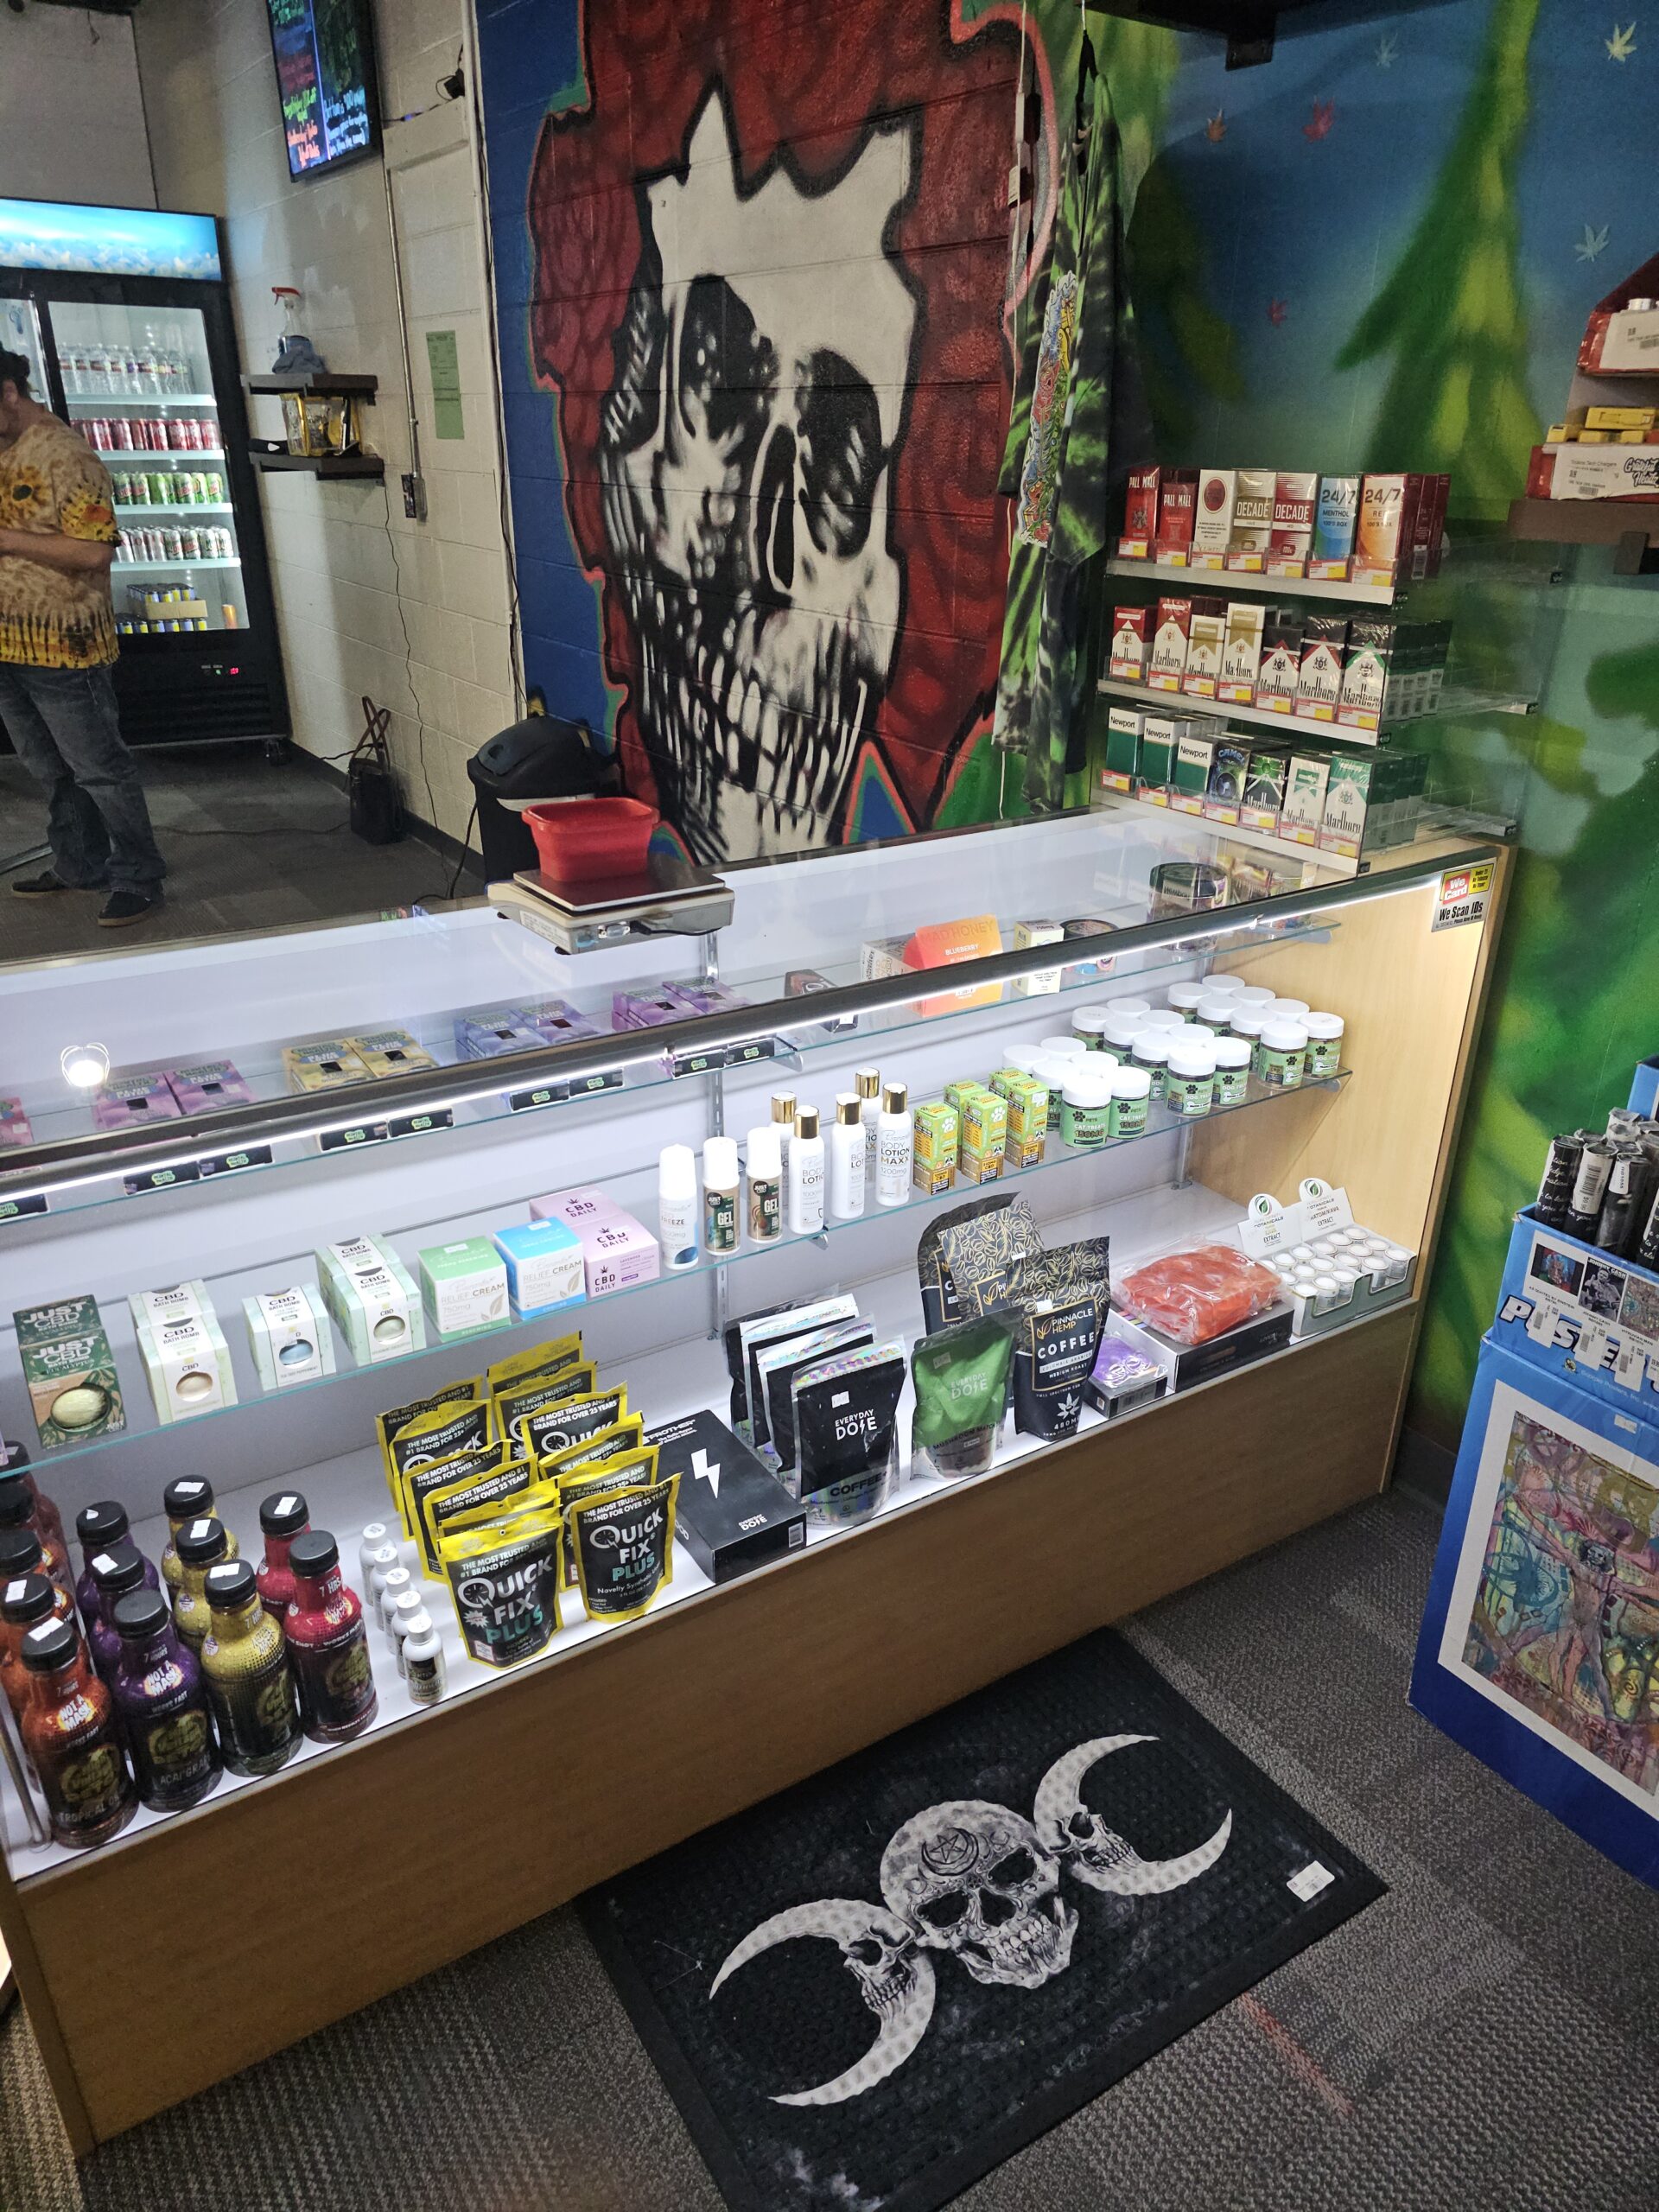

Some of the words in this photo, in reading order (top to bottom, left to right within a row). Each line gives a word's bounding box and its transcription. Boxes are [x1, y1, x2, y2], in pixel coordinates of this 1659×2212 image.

[1128, 476, 1140, 488] PALL
[1142, 476, 1155, 488] MALL
[1163, 494, 1175, 506] PALL
[1178, 494, 1192, 507] MALL
[1321, 489, 1356, 505] 24/7
[1364, 488, 1402, 505] 24/7
[1236, 501, 1268, 518] DECADE
[1275, 504, 1310, 520] DECADE
[1155, 648, 1181, 668] Marlboro
[1300, 677, 1335, 701] Marlboro
[1110, 716, 1135, 728] Newport
[1146, 728, 1171, 740] Newport
[1180, 746, 1208, 760] Newport
[1218, 748, 1245, 766] CAMEL
[1247, 792, 1280, 811] Marlboro
[1326, 810, 1361, 834] Marlboro
[1450, 877, 1466, 889] We
[1445, 885, 1468, 900] Card
[1440, 908, 1451, 921] We
[1452, 905, 1470, 918] Scan
[1471, 900, 1484, 914] IDs
[952, 920, 994, 938] HONEY
[945, 944, 979, 956] BLUEBERRY
[880, 1141, 905, 1150] BODY
[880, 1147, 910, 1157] LOTION
[565, 1202, 594, 1213] CBD
[570, 1207, 597, 1217] DAILY
[764, 1199, 779, 1212] GEL
[717, 1211, 734, 1225] GEL
[1318, 1217, 1333, 1226] EXTRACT
[601, 1236, 630, 1249] DAILY
[1263, 1233, 1281, 1243] EXTRACT
[341, 1244, 365, 1254] CBD
[552, 1260, 582, 1274] CREAM
[1588, 1258, 1610, 1270] JOHNNY
[1611, 1268, 1626, 1278] CASH
[360, 1274, 385, 1285] CBD
[594, 1274, 615, 1286] CBD
[595, 1282, 616, 1293] DAILY
[155, 1292, 184, 1302] CBD
[473, 1282, 505, 1297] CREAM
[270, 1296, 296, 1306] CBD
[23, 1301, 86, 1324] JUST
[34, 1312, 79, 1329] CBD
[1052, 1308, 1094, 1327] PINNACLE
[164, 1326, 194, 1338] CBD
[1052, 1321, 1077, 1334] HEMP
[32, 1335, 99, 1359] JUST
[163, 1336, 180, 1344] BATH
[1037, 1332, 1095, 1359] COFFEE
[43, 1346, 91, 1364] CBD
[181, 1363, 199, 1371] CBD
[1049, 1369, 1070, 1378] MEDIUM
[1071, 1363, 1087, 1372] ROAST
[950, 1372, 986, 1387] EVERYDAY
[448, 1389, 461, 1399] AND
[527, 1393, 543, 1404] MOST
[544, 1385, 568, 1397] TRUSTED
[533, 1416, 545, 1425] THE
[546, 1409, 564, 1421] MOST
[565, 1402, 591, 1414] TRUSTED
[534, 1420, 556, 1431] BRAND
[558, 1415, 571, 1425] FOR
[572, 1409, 589, 1421] OVER
[590, 1406, 597, 1414] 25
[598, 1400, 618, 1412] YEARS
[835, 1408, 874, 1427] EVERYDAY
[407, 1440, 420, 1449] THE
[421, 1434, 439, 1445] MOST
[440, 1421, 465, 1438] TRUSTED
[416, 1440, 440, 1452] BRAND
[441, 1436, 453, 1445] FOR
[442, 1471, 455, 1481] FOR
[457, 1461, 474, 1473] OVER
[482, 1447, 501, 1461] YEARS
[572, 1454, 589, 1468] MOST
[589, 1444, 613, 1462] TRUSTED
[417, 1473, 429, 1483] THE
[430, 1465, 449, 1477] MOST
[583, 1481, 603, 1491] MOST
[604, 1471, 629, 1485] TRUSTED
[630, 1465, 645, 1475] AND
[438, 1499, 451, 1508] THE
[453, 1491, 473, 1503] MOST
[474, 1478, 500, 1495] TRUSTED
[501, 1471, 515, 1482] AND
[517, 1465, 524, 1474] #1
[466, 1496, 480, 1504] FOR
[480, 1486, 499, 1499] OVER
[499, 1482, 508, 1491] 25
[509, 1472, 528, 1485] YEARS
[583, 1509, 596, 1517] THE
[597, 1503, 616, 1515] MOST
[617, 1492, 643, 1507] TRUSTED
[583, 1515, 607, 1524] BRAND
[609, 1509, 623, 1517] FOR
[625, 1501, 642, 1512] OVER
[652, 1489, 669, 1502] YEARS
[590, 1507, 664, 1549] QUICK
[462, 1562, 476, 1571] THE
[478, 1554, 498, 1567] MOST
[499, 1544, 529, 1560] TRUSTED
[620, 1539, 652, 1564] FIX
[472, 1564, 498, 1575] BRAND
[613, 1552, 655, 1581] PLUS
[319, 1586, 325, 1598] 7
[327, 1577, 341, 1594] HRS
[457, 1554, 553, 1609] QUICK
[597, 1586, 624, 1594] Novelty
[494, 1591, 535, 1625] FIX
[485, 1605, 543, 1644] PLUS
[150, 1647, 168, 1662] HOURS
[147, 1667, 163, 1685] NOT
[165, 1659, 172, 1670] A
[151, 1669, 180, 1695] MASK
[59, 1700, 79, 1719] NOT
[76, 1694, 85, 1704] A
[175, 1691, 188, 1705] FAST
